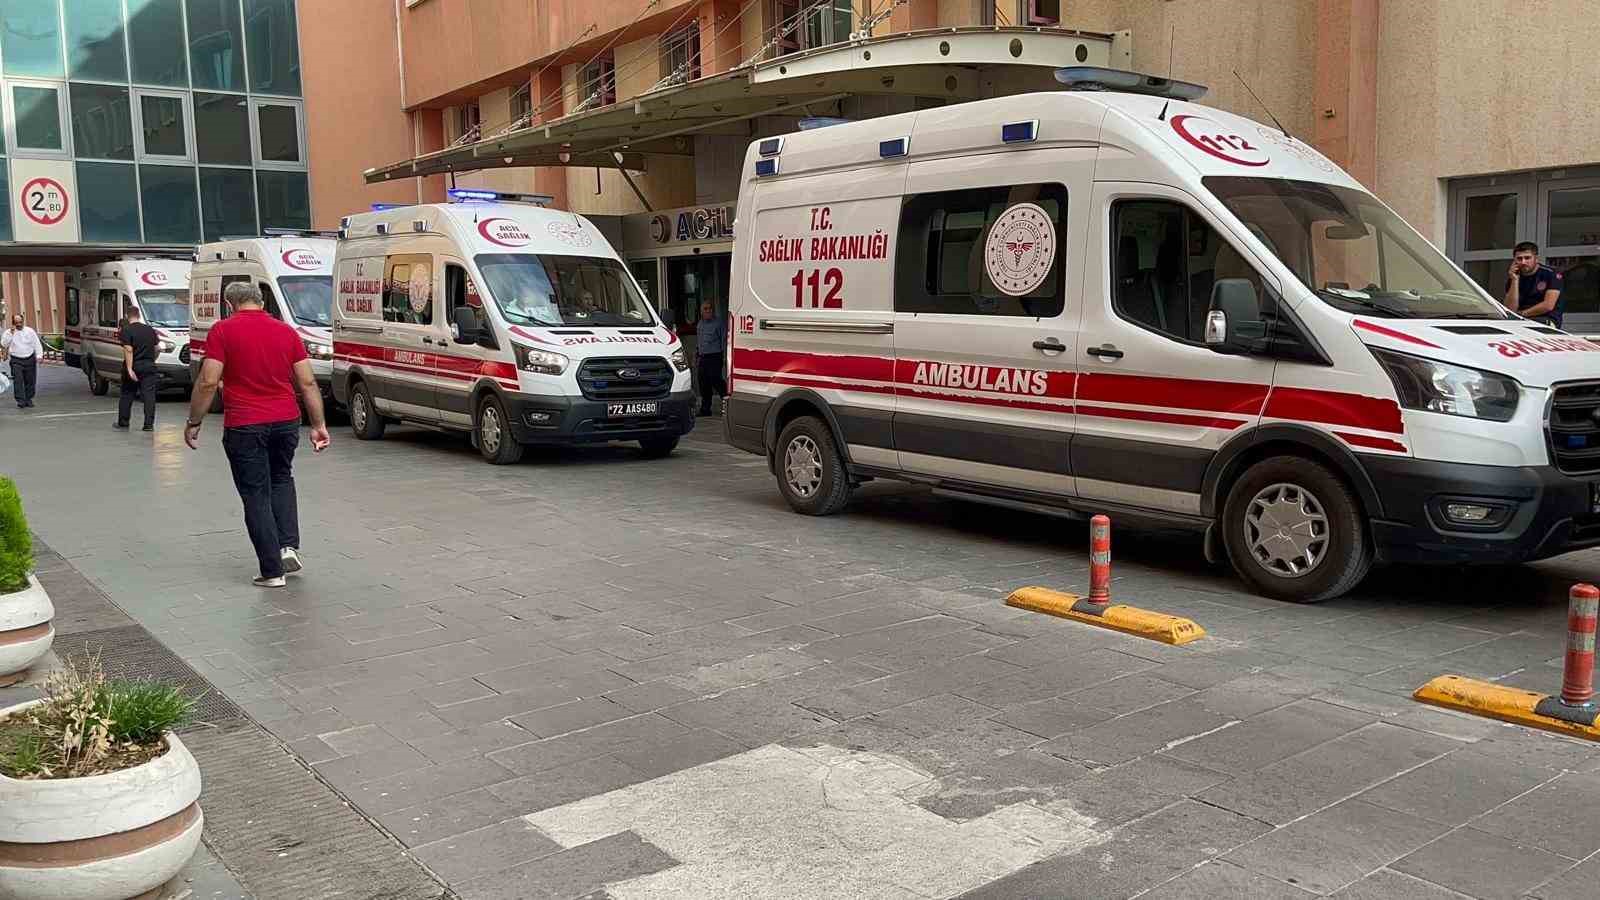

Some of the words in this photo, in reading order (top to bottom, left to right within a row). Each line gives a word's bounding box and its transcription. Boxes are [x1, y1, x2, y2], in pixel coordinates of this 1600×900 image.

[1200, 134, 1259, 150] 112
[31, 191, 45, 211] 2
[811, 207, 833, 231] T.C.
[759, 234, 804, 262] SAĞLIK
[810, 228, 889, 260] BAKANLIĞI
[792, 267, 843, 308] 112
[740, 315, 754, 334] 112
[913, 362, 1048, 395] AMBULANS
[613, 405, 624, 415] 72
